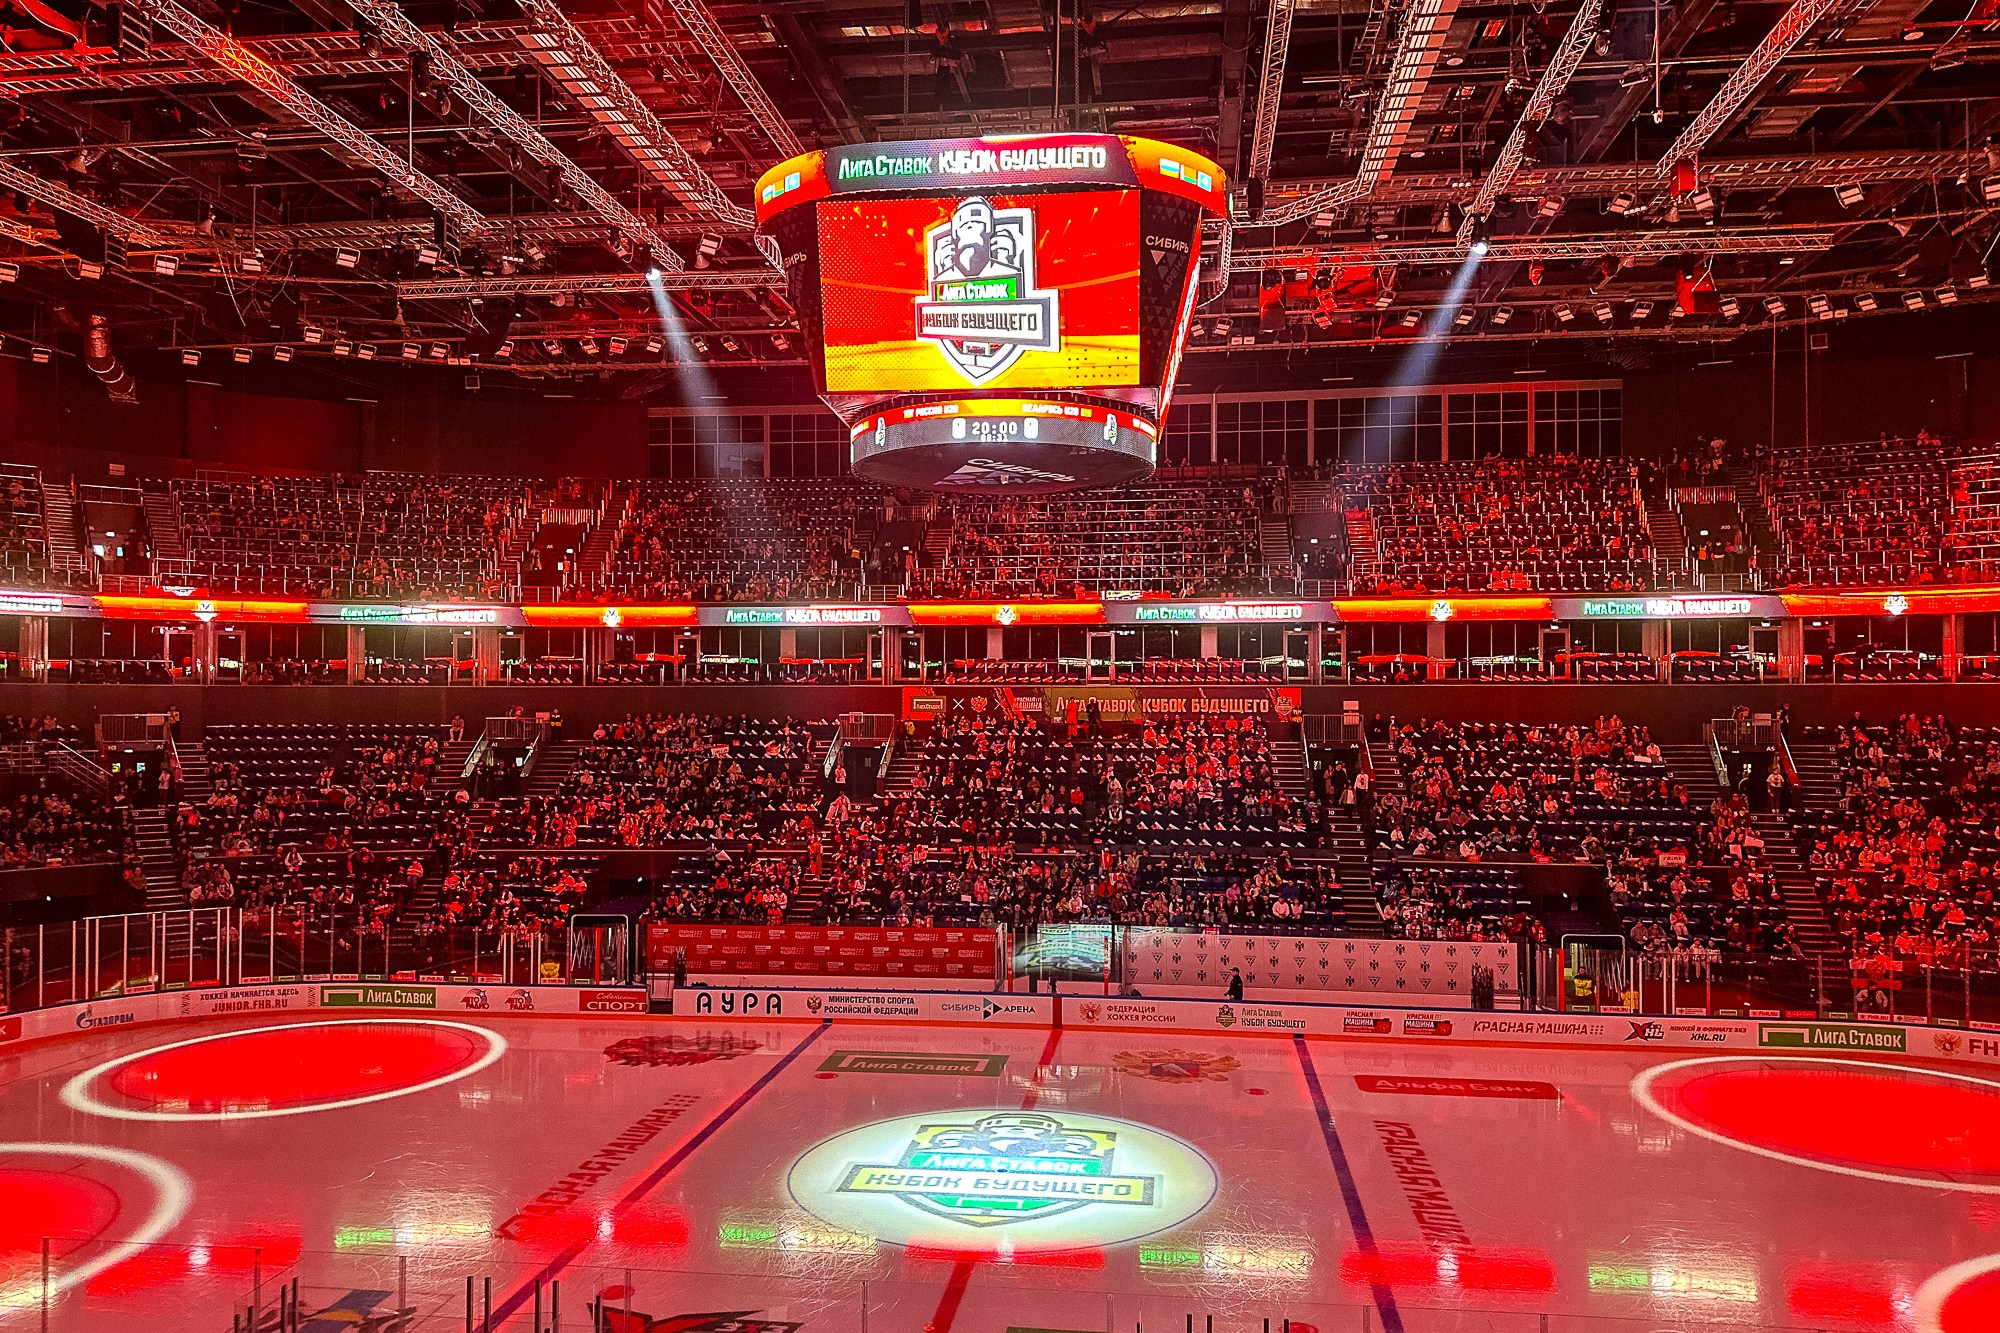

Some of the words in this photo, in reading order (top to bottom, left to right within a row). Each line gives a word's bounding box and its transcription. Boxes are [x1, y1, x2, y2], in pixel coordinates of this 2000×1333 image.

[839, 157, 875, 179] ЛИГА
[876, 155, 932, 175] СТАВОК
[938, 149, 998, 174] КУБОК
[999, 147, 1107, 172] БУДУЩЕГО
[1145, 235, 1189, 253] СИБИРЬ
[961, 313, 1038, 332] БУДУЩЕГО
[972, 421, 1018, 435] 20:00
[967, 458, 1076, 482] СИБИРЬ
[1143, 698, 1187, 714] КУБОК
[1191, 698, 1269, 714] БУДУЩЕГО
[200, 990, 228, 1001] ХОККЕЙ
[230, 989, 275, 999] НАЧИНАЕТСЯ
[277, 987, 300, 997] ЗДЕСЬ
[367, 989, 393, 1004] ЛИГА
[394, 990, 433, 1005] СТАВОК
[828, 995, 885, 1005] МИНИСТЕРСТВО
[886, 996, 915, 1006] СПОРТА
[211, 998, 288, 1013] JUNIOR.FHR.RU
[586, 1001, 646, 1011] СПОРТ
[697, 992, 782, 1015] АУРА
[824, 1005, 872, 1015] РОССИЙСКОЙ
[873, 1006, 919, 1016] ФЕДЕРАЦИИ
[942, 1003, 981, 1012] СИБИРЬ
[1003, 1005, 1036, 1014] АРЕНА
[1106, 1005, 1156, 1015] ФЕДЕРАЦИЯ
[1106, 1013, 1140, 1022] ХОККЕЯ
[1141, 1014, 1176, 1023] РОССИИ
[1241, 1008, 1258, 1017] ЛИГА
[90, 1013, 135, 1029] ГАЗПРОМ
[1241, 1018, 1266, 1027] КУБОК
[1267, 1019, 1306, 1029] БУДУЩЕГО
[1345, 1018, 1374, 1026] МАШИНА
[1405, 1020, 1434, 1028] МАШИНА
[1473, 1021, 1534, 1035] КРАСНАЯ
[1535, 1022, 1588, 1036] МАШИНА
[1624, 1021, 1665, 1042] XHL
[1690, 1033, 1727, 1042] XHL.RU
[1814, 1028, 1848, 1046] ЛИГА
[1849, 1030, 1902, 1048] СТАВОК
[852, 1061, 898, 1070] ЛИГА
[901, 1062, 972, 1072] СТАВОК
[1375, 1078, 1465, 1091] Альфа
[1469, 1083, 1540, 1093] Банк
[922, 1155, 986, 1170] ЛИГА
[989, 1158, 1089, 1174] СТАВОК
[864, 1172, 963, 1188] КУБОК
[973, 1177, 1132, 1197] БУДУЩЕГО
